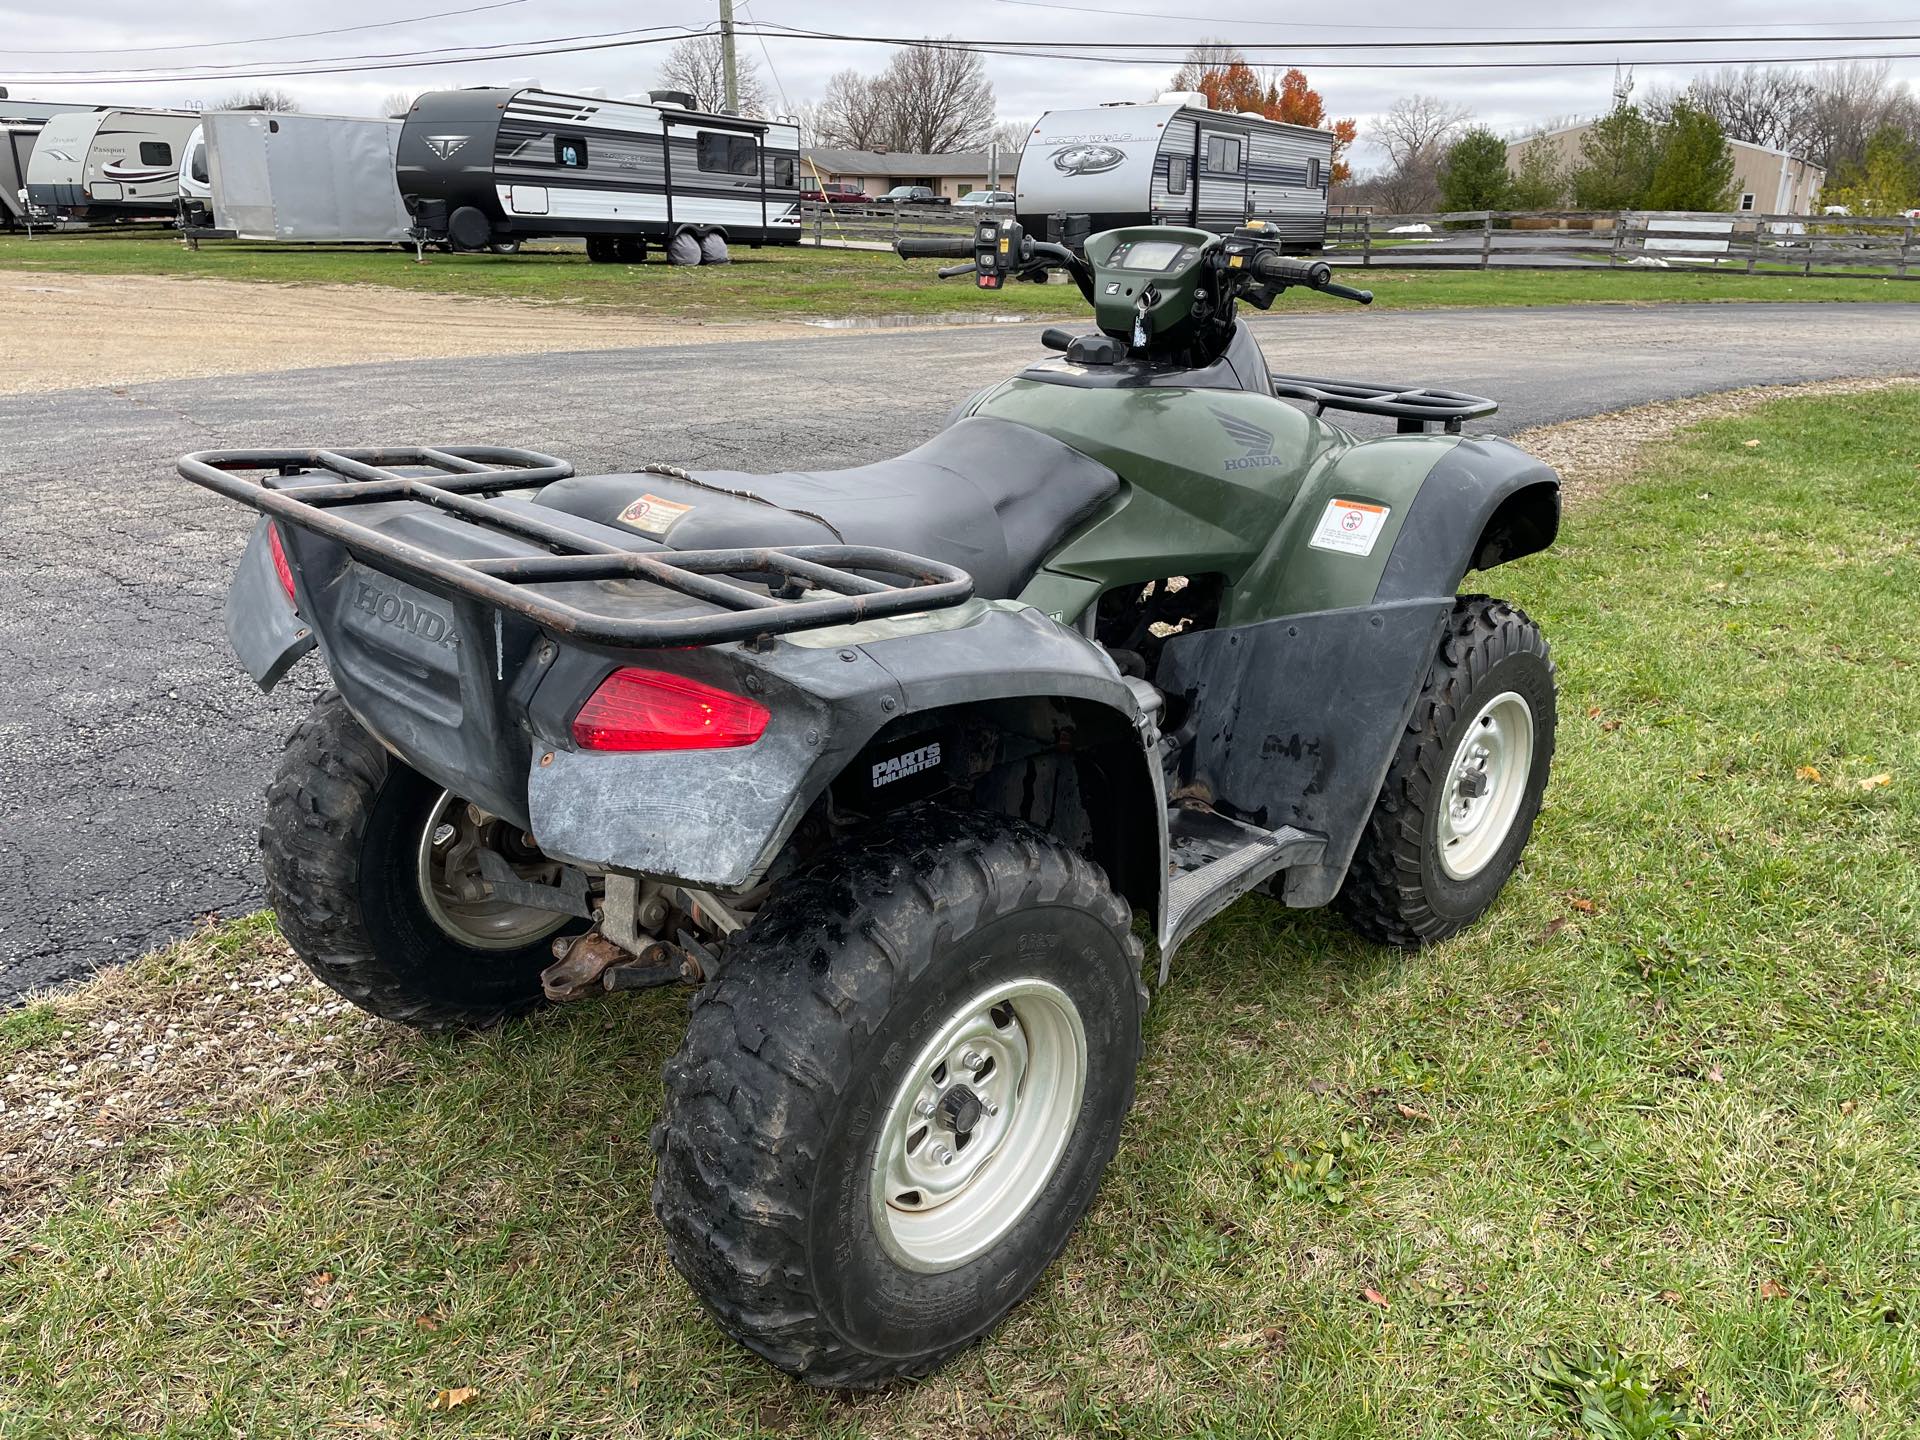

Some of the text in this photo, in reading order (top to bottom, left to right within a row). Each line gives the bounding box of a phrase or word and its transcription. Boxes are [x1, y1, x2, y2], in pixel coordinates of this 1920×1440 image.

[1223, 455, 1282, 471] HONDA
[353, 582, 461, 649] HONDA
[872, 742, 941, 779] PARTS
[873, 756, 941, 788] UNLIMITED
